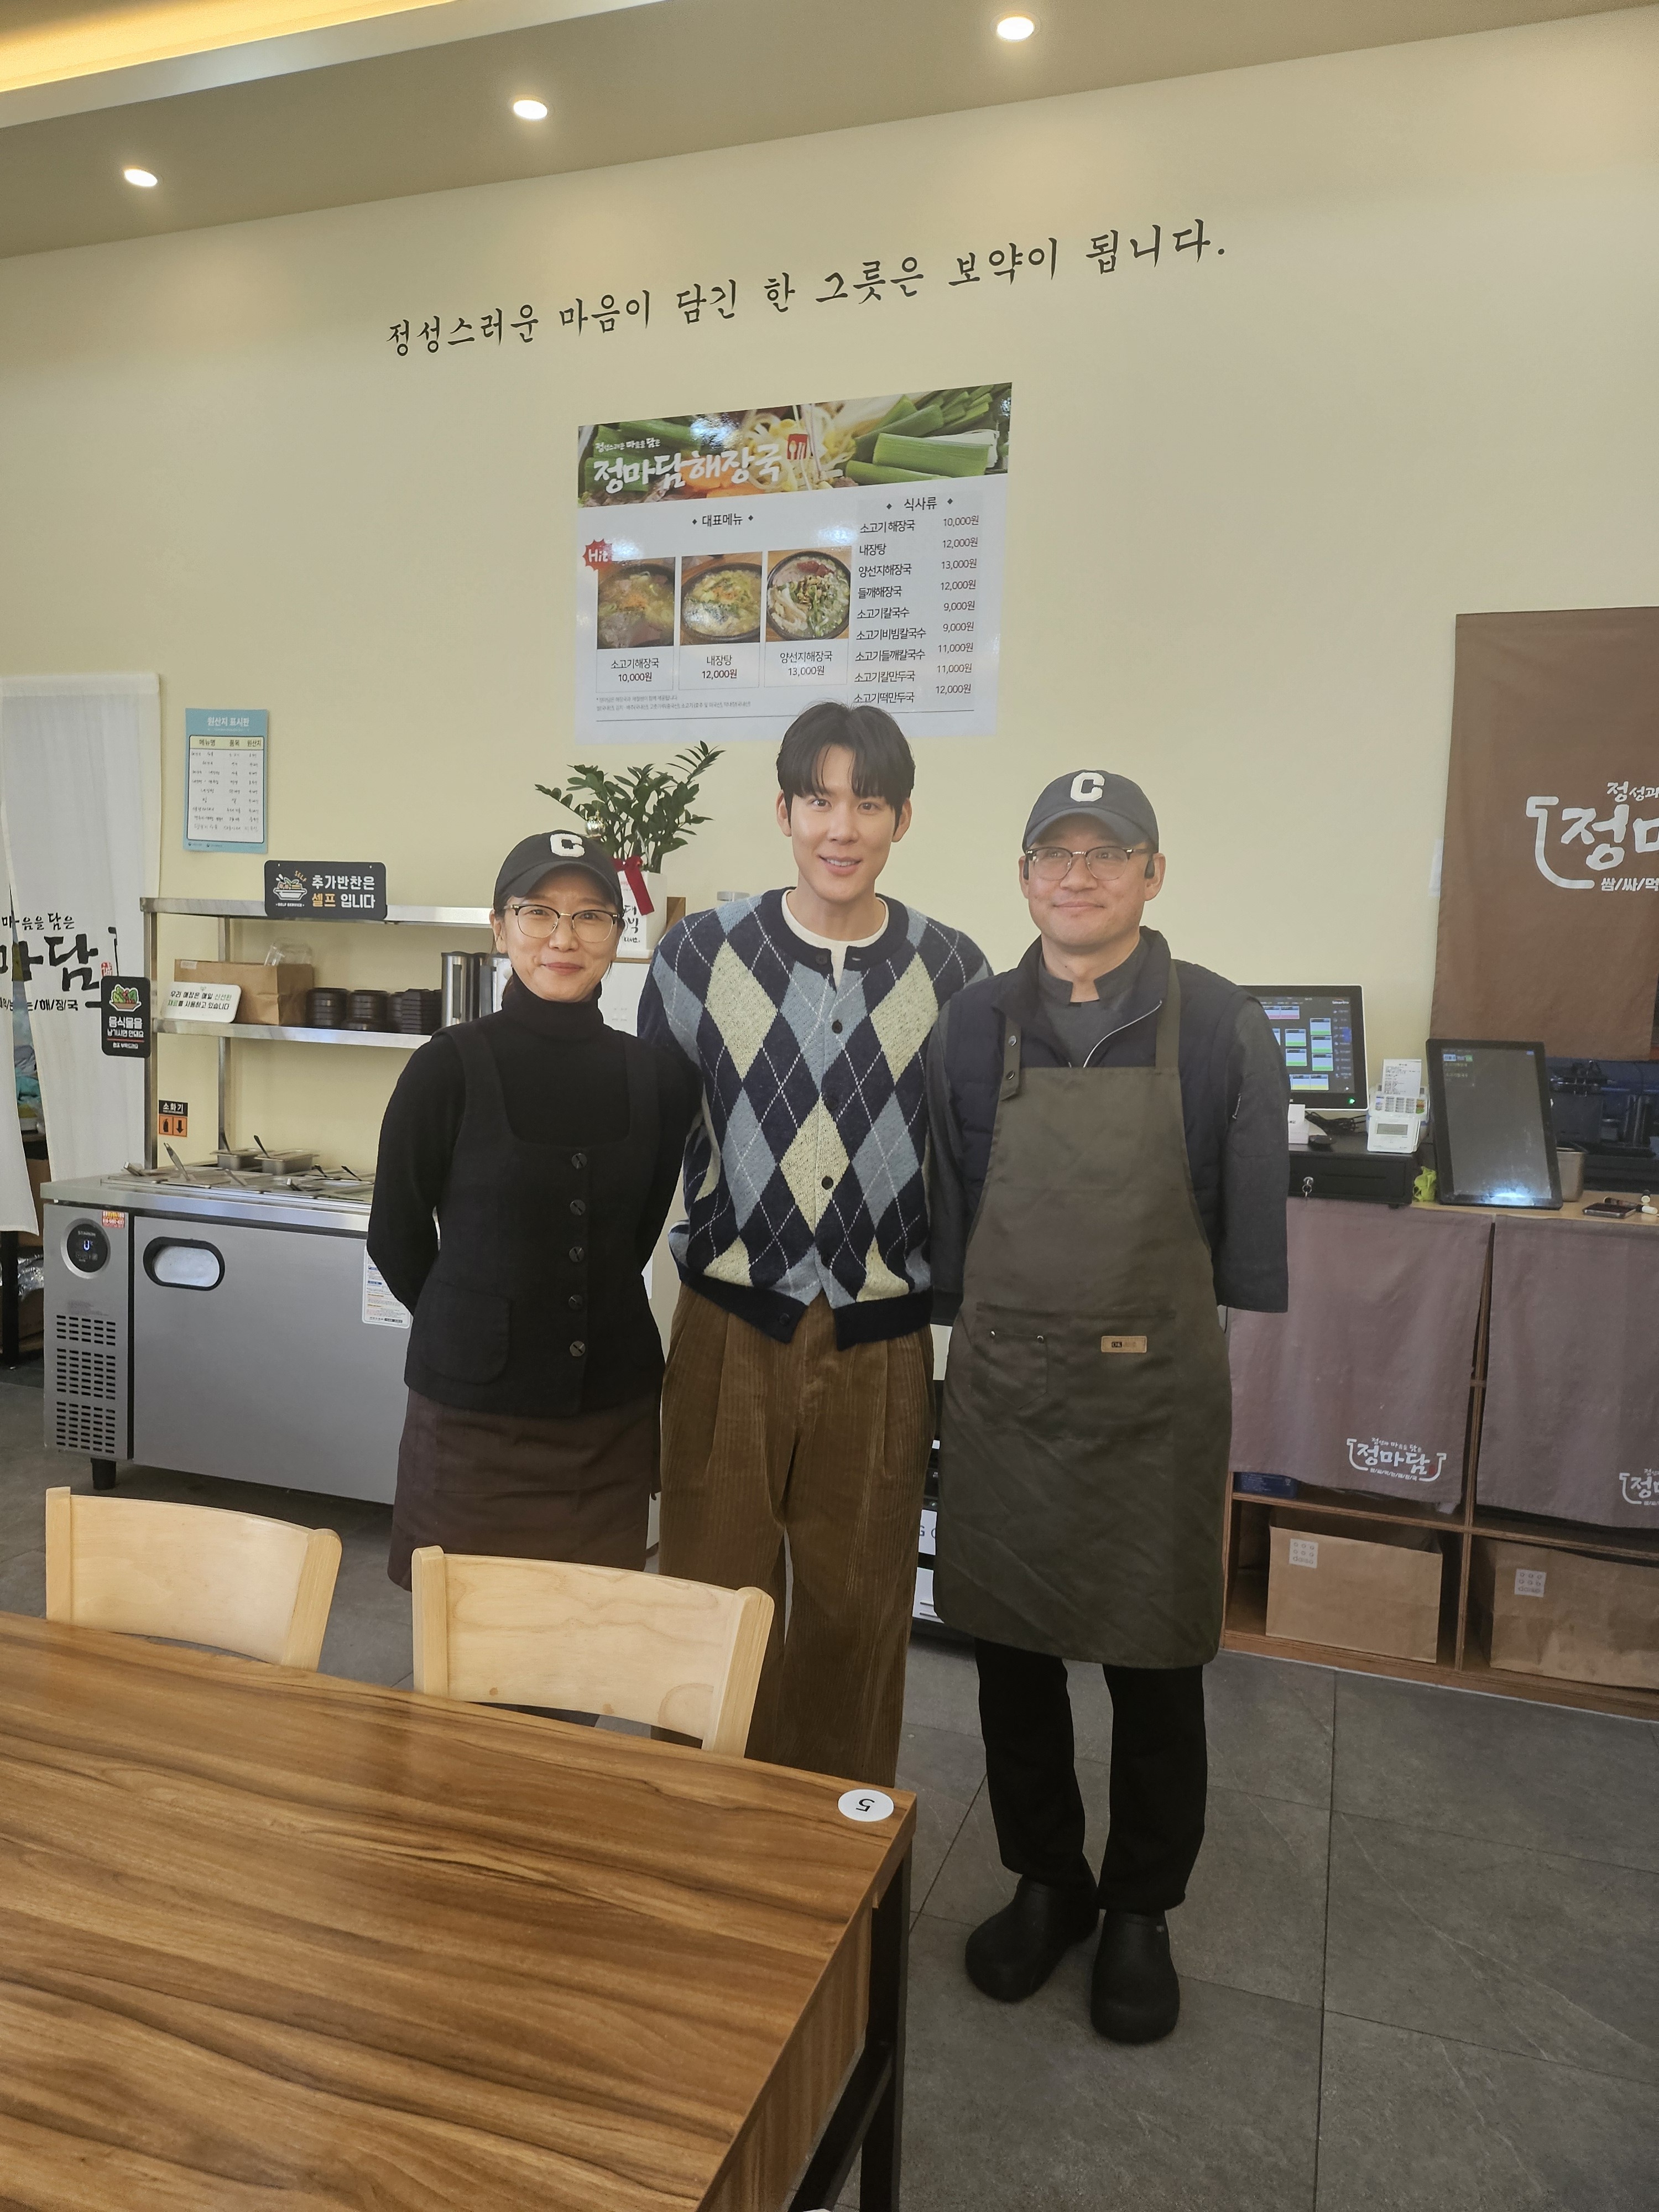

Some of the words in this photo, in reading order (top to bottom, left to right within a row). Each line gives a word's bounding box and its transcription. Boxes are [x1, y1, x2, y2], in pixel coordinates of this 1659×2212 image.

[386, 304, 539, 357] 정성스러운
[559, 290, 651, 337] 마음이
[676, 279, 737, 323] 담긴
[763, 272, 795, 312] 한
[815, 256, 924, 304] 그릇은
[947, 237, 1057, 286] 보약이
[1085, 218, 1225, 274] 됩니다.
[904, 497, 937, 512] 식사류
[702, 513, 743, 526] 대표메뉴
[943, 515, 979, 528] 10,000원
[859, 543, 886, 556] 내장탕
[942, 537, 978, 549] 12,000원
[588, 549, 608, 562] Hit
[858, 563, 912, 578] 양선지해장국
[941, 559, 977, 570] 13,000원
[858, 586, 902, 599] 들깨해장국
[941, 580, 977, 591] 12,000원
[857, 607, 910, 619] 소고기칼국수
[943, 601, 975, 612] 9,000원
[856, 627, 927, 640] 소고기비빔칼국수
[943, 622, 974, 633] 9,000원
[779, 650, 833, 664] 양선지해장국
[855, 649, 926, 662] 소고기들깨칼국수
[937, 642, 974, 654] 11,000원
[611, 658, 660, 669] 소고기해장국
[706, 655, 733, 666] 내장탕
[618, 672, 653, 684] 10,000원
[701, 669, 738, 681] 12,000원
[787, 665, 825, 677] 13,000원
[854, 670, 916, 683] 소고기칼만두국
[937, 663, 972, 674] 11,000원
[853, 692, 915, 703] 소고기떡만두국
[935, 684, 972, 696] 12,000원
[207, 717, 228, 726] 원산지
[247, 739, 262, 747] 원산지
[1071, 772, 1105, 802] C
[550, 833, 585, 857] C
[311, 874, 375, 890] 추가반찬은
[312, 893, 336, 907] 셀프
[340, 893, 375, 909] 입니다
[48, 912, 75, 930] 담은
[185, 1000, 207, 1009] 사용하고
[163, 1102, 184, 1112] 소화기
[1357, 1443, 1431, 1475] 정마담
[1630, 1477, 1659, 1498] 정
[855, 1798, 875, 1812] 5
